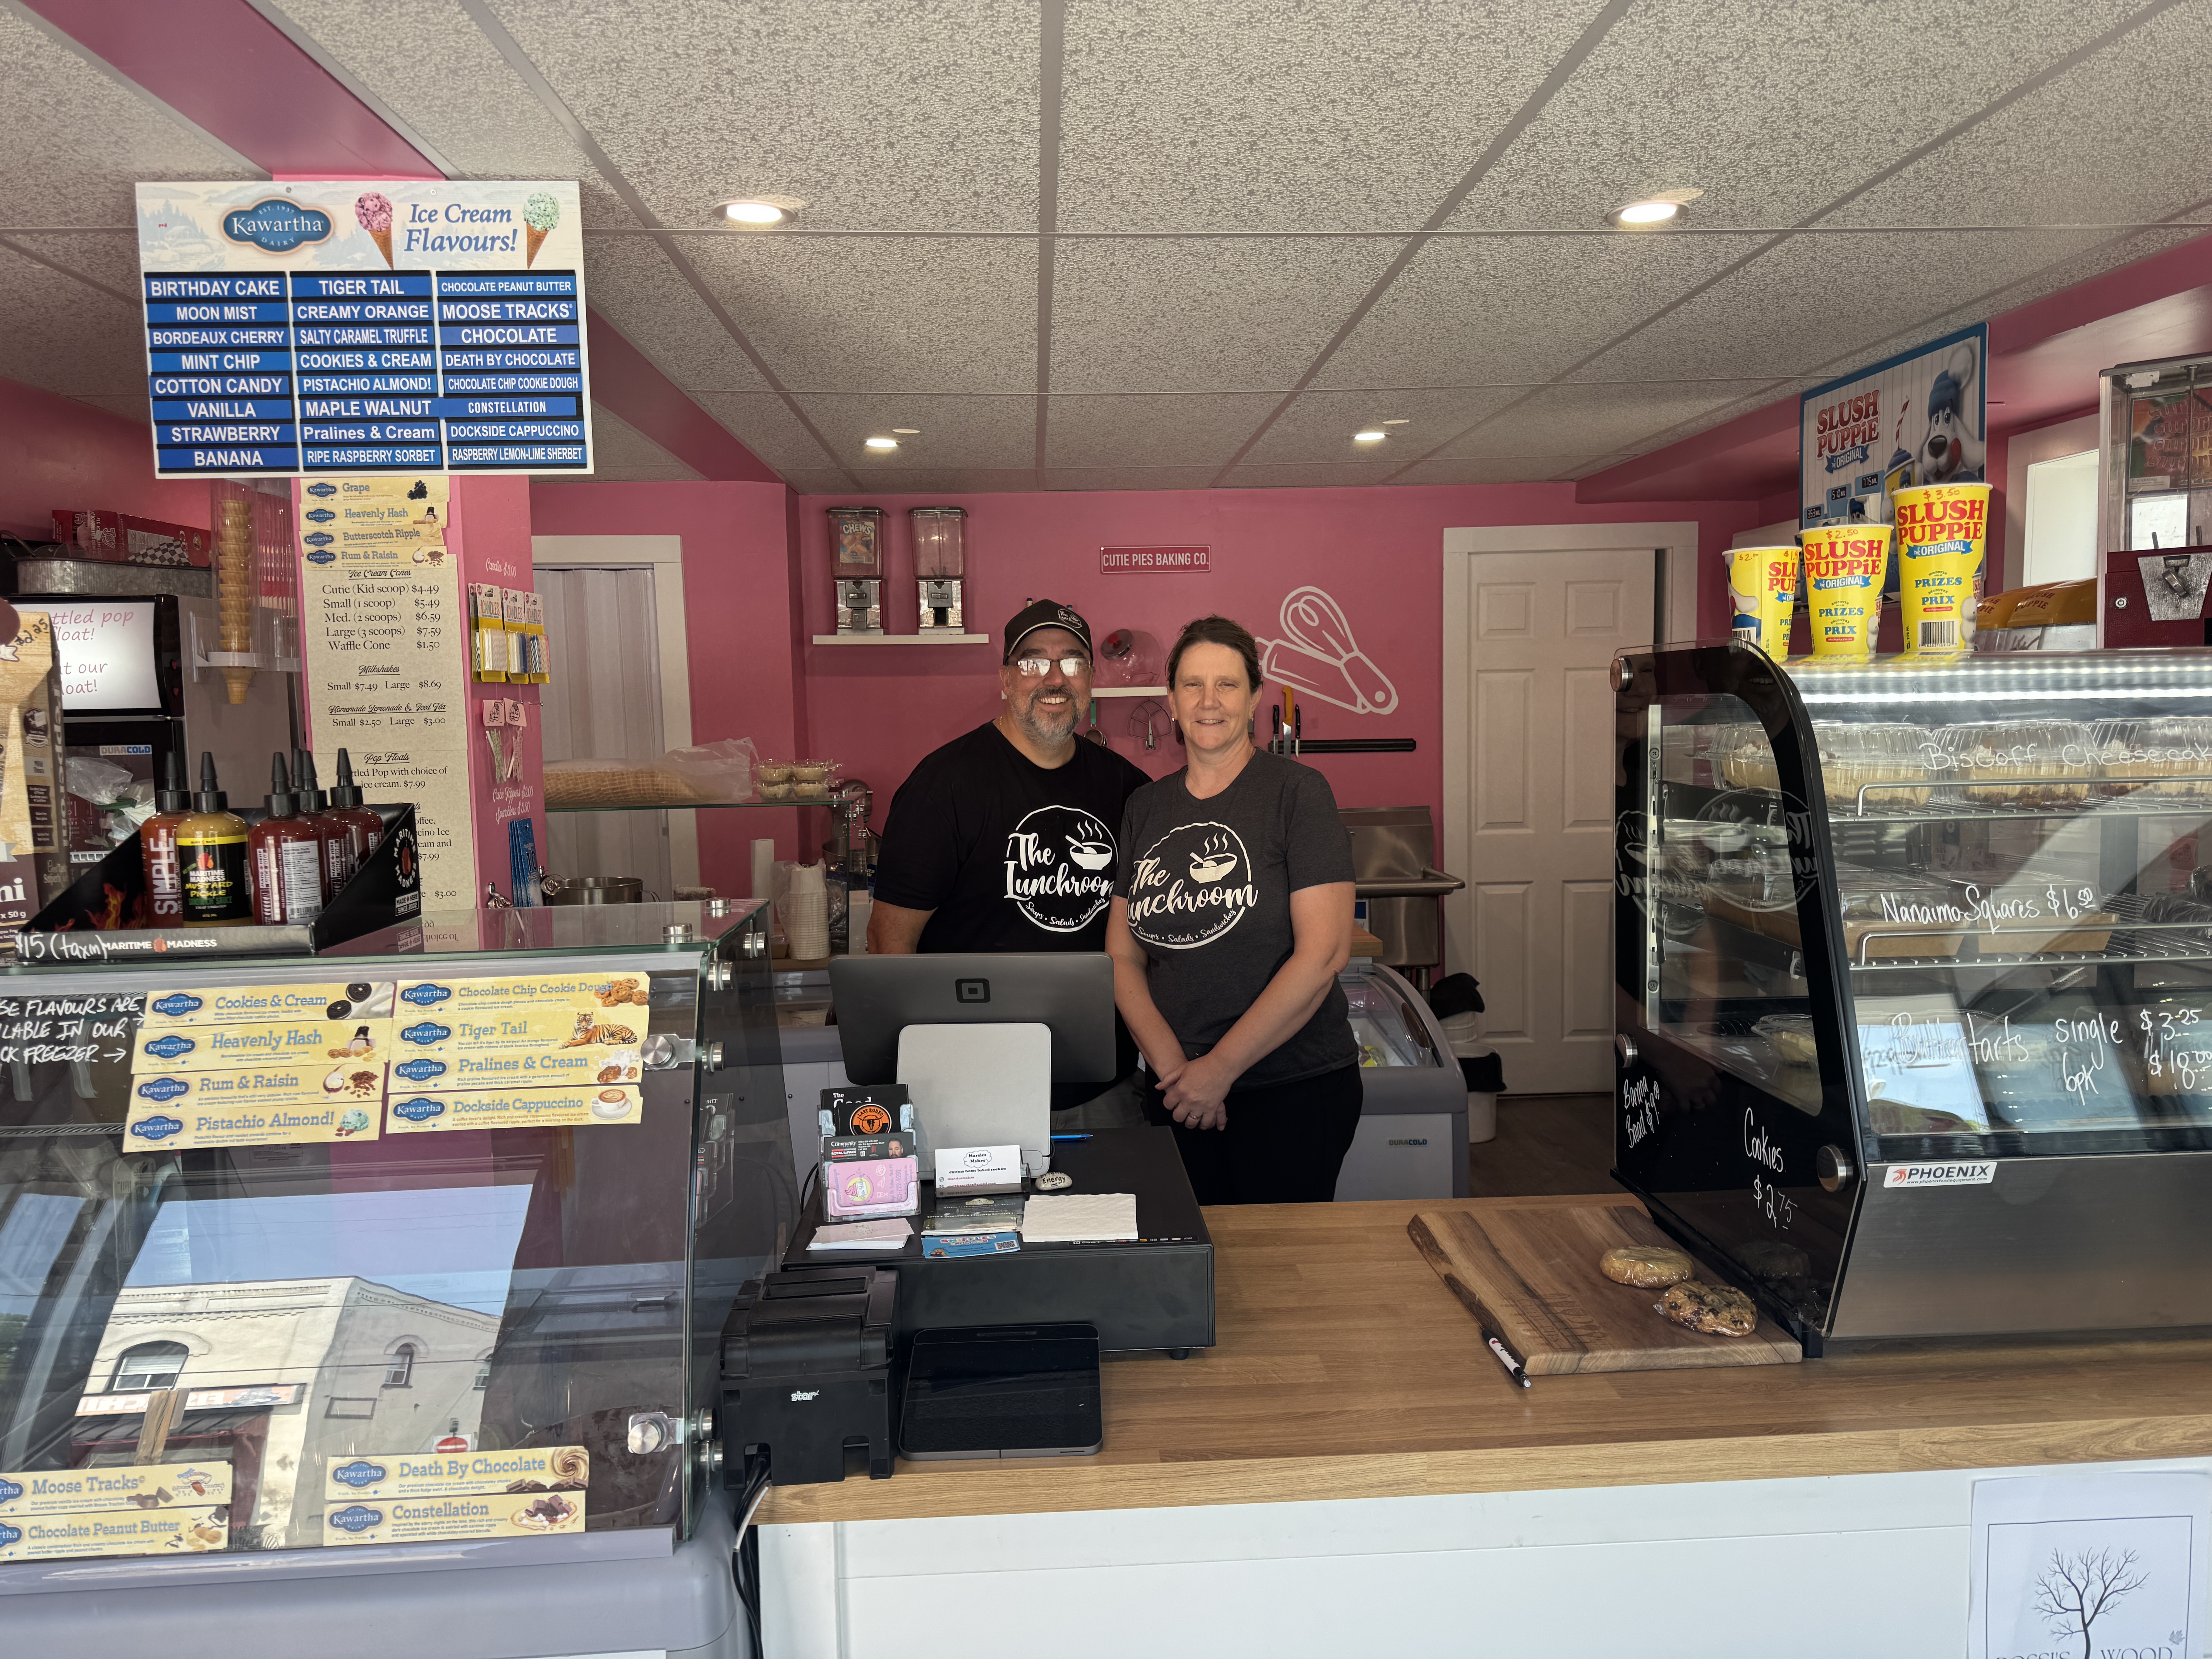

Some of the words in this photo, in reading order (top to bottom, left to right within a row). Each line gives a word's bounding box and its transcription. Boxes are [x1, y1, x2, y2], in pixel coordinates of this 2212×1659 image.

[259, 206, 273, 215] EST.
[277, 205, 295, 214] 1937
[409, 204, 437, 223] Ice
[439, 204, 511, 223] Cream
[232, 216, 322, 235] Kawartha
[261, 237, 294, 246] DAIRY
[404, 228, 517, 252] Flavours!
[151, 281, 230, 296] BIRTHDAY
[235, 281, 279, 295] CAKE
[319, 280, 366, 295] TIGER
[371, 280, 404, 294] TAIL
[441, 282, 496, 292] CHOCOLATE
[498, 282, 533, 292] PEANUT
[537, 282, 571, 291] BUTTER
[177, 307, 219, 320] MOON
[225, 307, 257, 320] MIST
[301, 354, 364, 368] COOKIES
[368, 354, 378, 367] &
[381, 354, 431, 367] CREAM
[156, 379, 221, 394] COTTON
[227, 378, 282, 393] CANDY
[448, 378, 496, 390] CHOCOLATE
[498, 378, 516, 389] CHIP
[518, 377, 547, 389] COOKIE
[550, 377, 578, 388] DOUGH
[187, 403, 256, 417] VANILLA
[468, 401, 546, 413] CONSTELLATION
[1817, 390, 1879, 434] SLUSH
[172, 426, 280, 442] STRAWBERRY
[194, 451, 263, 466] BANANA
[307, 451, 330, 463] RIPE
[333, 450, 392, 462] RASPBERRY
[395, 450, 435, 462] SORBET
[452, 448, 498, 461] RASPBERRY
[500, 448, 545, 460] LEMON-LIME
[547, 447, 582, 459] SHERBET
[1836, 448, 1863, 469] ORIGINAL
[342, 483, 370, 493] Grape
[1923, 488, 1960, 500] $3.50
[345, 509, 385, 520] Heavenly
[387, 508, 408, 518] Hash
[1898, 500, 1984, 525] SLUSH
[343, 531, 393, 540] Butterscotch
[395, 529, 421, 539] Ripple
[842, 522, 872, 536] CHEWS
[1920, 542, 1964, 556] ORIGINAL
[1103, 553, 1130, 568] CUTIE
[1132, 553, 1153, 567] PIES
[1156, 552, 1191, 567] BAKING
[1194, 552, 1209, 565] CO.
[322, 585, 350, 594] Cutie
[353, 584, 374, 594] (Kid
[377, 584, 409, 594] scoop)
[412, 584, 439, 594] $4.49
[1915, 577, 1962, 588] PRIZES
[323, 599, 350, 609] Small
[364, 599, 395, 609] scoop)
[414, 599, 440, 608] $5.49
[1922, 594, 1954, 605] PRIX
[101, 610, 134, 627] pop
[328, 641, 361, 650] Waffle
[363, 641, 390, 650] Cone
[417, 641, 440, 650] $1.50
[79, 663, 108, 674] our
[359, 665, 400, 674] Milkshakes
[329, 704, 366, 714] Homemade
[369, 704, 402, 713] Lemonade
[405, 703, 412, 712] &
[416, 703, 431, 711] Iced
[433, 702, 446, 711] Tea
[101, 746, 151, 754] DURACOLD
[1920, 742, 2037, 771] Biscoff
[2062, 743, 2212, 768] Cheesecak
[364, 754, 382, 763] Pop
[385, 753, 409, 763] Floats
[1008, 832, 1056, 871] The
[149, 837, 178, 914] SIMPLE
[1133, 857, 1171, 894] The
[1127, 881, 1258, 927] unchroom
[1881, 892, 1966, 924] Nanaimo
[1961, 885, 2040, 934] Squares
[1138, 926, 1159, 941] Soups
[1168, 933, 1194, 943] Salads
[1200, 909, 1237, 938] Sandwiches
[105, 942, 152, 950] MARITIME
[167, 939, 217, 947] MADNESS
[27, 998, 106, 1017] FLAVOURS
[112, 997, 144, 1012] ARE
[156, 998, 200, 1010] Kawartha
[215, 996, 268, 1010] Cookies
[271, 995, 282, 1007] &
[285, 993, 327, 1006] Cream
[59, 1021, 82, 1037] IN
[93, 1025, 126, 1038] OUR
[24, 1044, 98, 1065] FREEZER
[1623, 1076, 1649, 1109] Banana
[453, 1099, 510, 1112] Dockside
[513, 1097, 583, 1112] Cappuccino
[196, 1116, 265, 1131] Pistachio
[269, 1111, 334, 1127] Almond!
[1626, 1109, 1647, 1148] Bread
[1744, 1107, 1784, 1173] Cookies
[1908, 1165, 1990, 1179] PHOENIX
[791, 1390, 819, 1401] star
[337, 1468, 382, 1480] Kawartha
[399, 1462, 443, 1478] Death
[448, 1460, 469, 1478] By
[472, 1457, 545, 1474] Chocolate
[393, 1502, 489, 1520] Constellation
